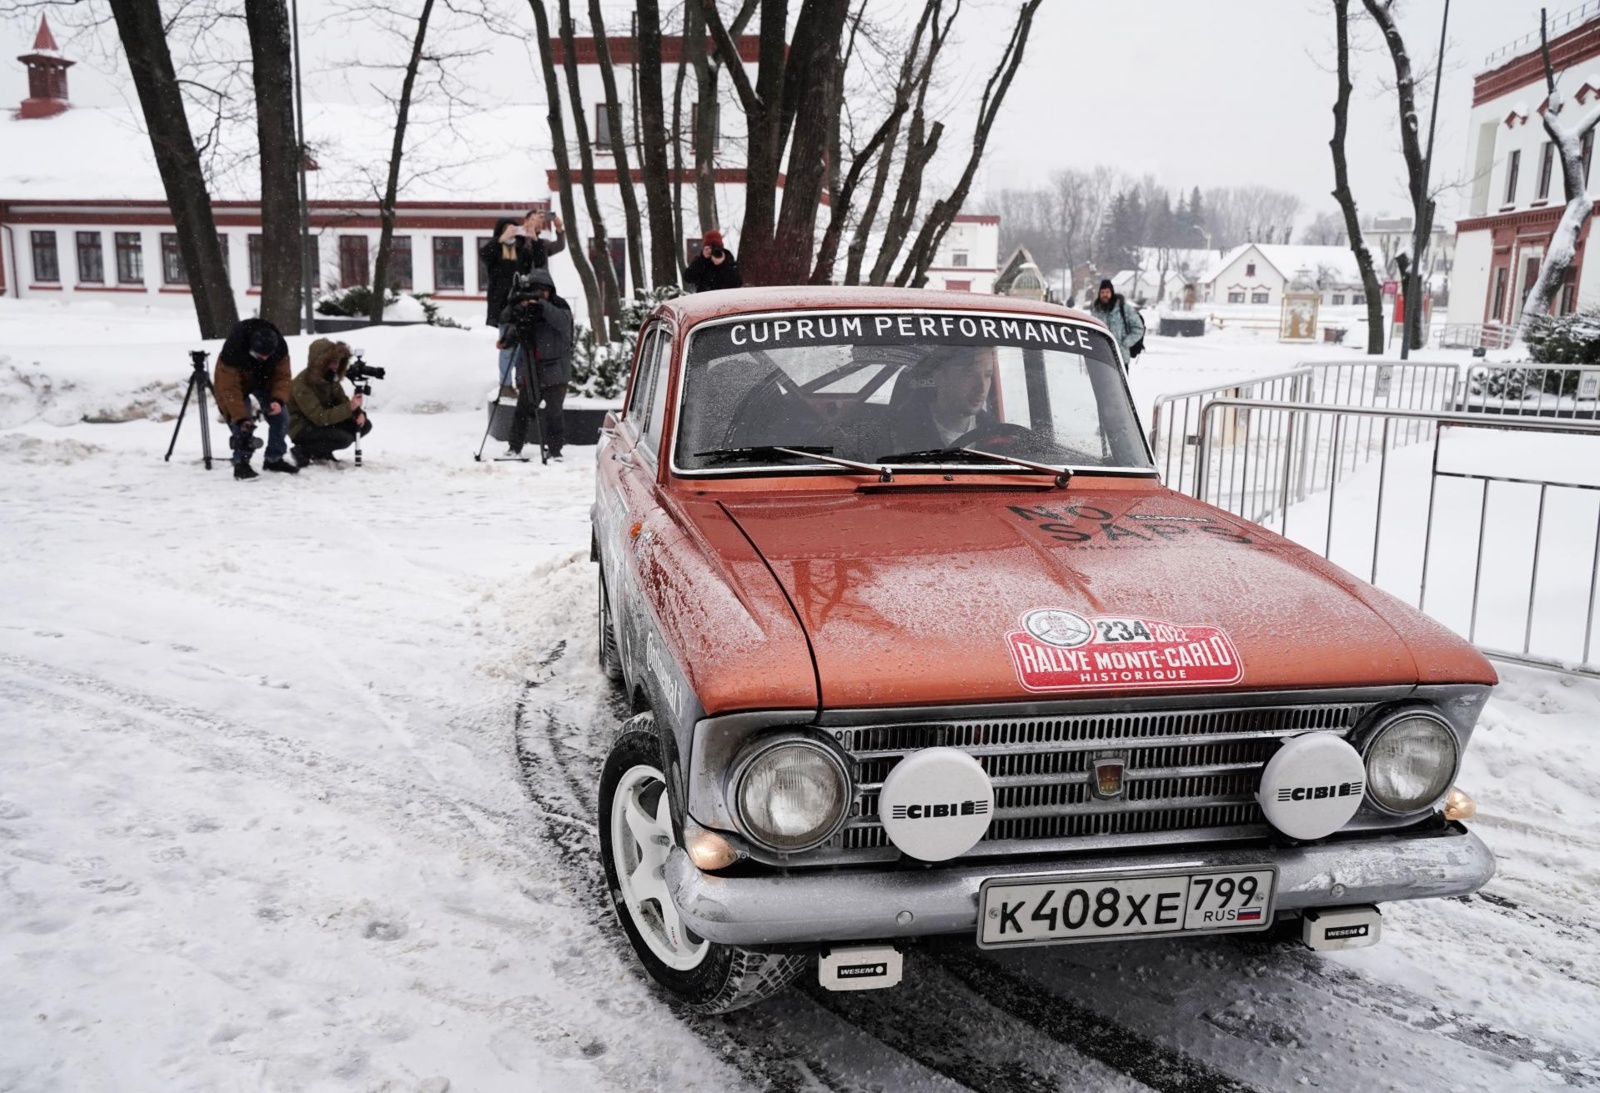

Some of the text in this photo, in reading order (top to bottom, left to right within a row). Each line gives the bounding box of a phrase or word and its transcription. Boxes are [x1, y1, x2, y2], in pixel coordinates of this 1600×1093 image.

[730, 317, 1093, 350] CUPRUM PERFORMANCE
[1005, 504, 1114, 521] NO
[1097, 619, 1151, 642] 234
[1151, 624, 1190, 643] 2022
[1017, 635, 1232, 673] RALLYE MONTE-CARLO
[1080, 669, 1187, 683] HISTORIQUE
[1193, 876, 1258, 911] 799
[1203, 909, 1236, 922] RUS
[1327, 928, 1358, 937] WESEM
[840, 967, 875, 976] WESEM
